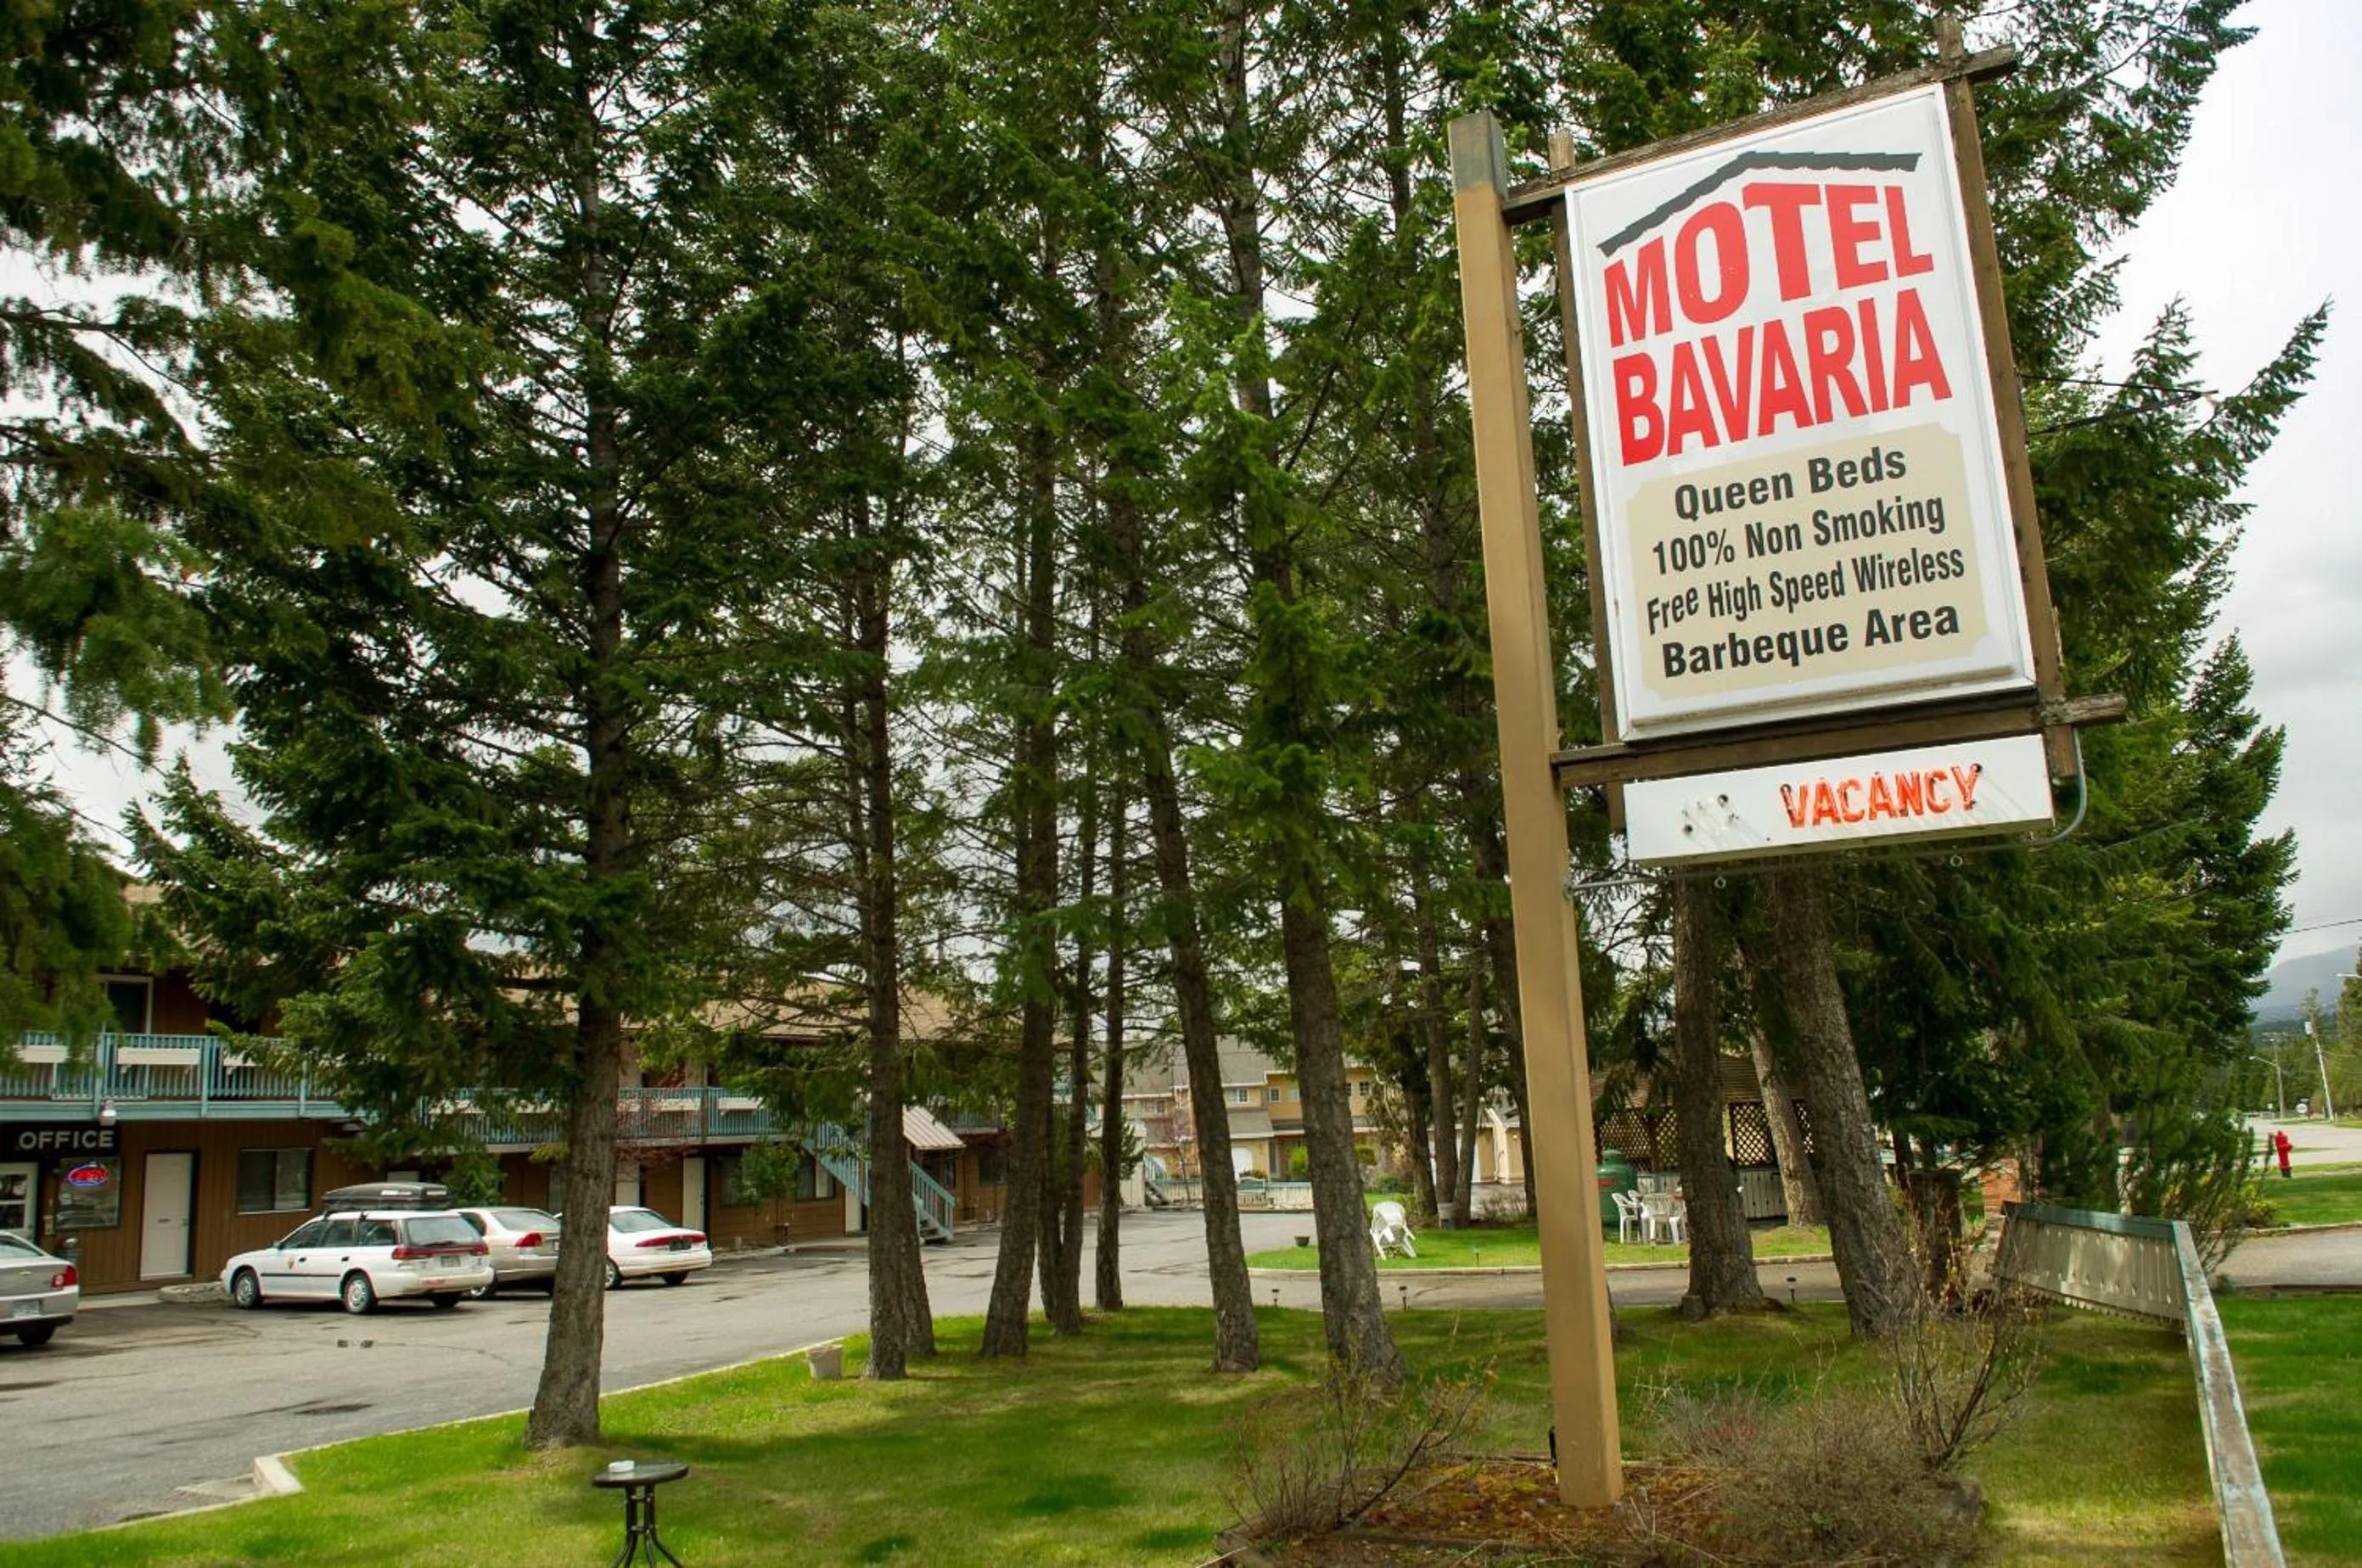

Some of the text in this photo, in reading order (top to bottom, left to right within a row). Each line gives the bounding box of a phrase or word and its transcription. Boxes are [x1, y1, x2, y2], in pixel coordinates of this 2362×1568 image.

[1603, 182, 1934, 349] MOTEL
[1612, 288, 1952, 468] BAVARIA
[1675, 446, 1906, 522] Queen Beds
[1652, 495, 1945, 575] 100% Non Smoking
[1647, 547, 1965, 636] Free High Speed Wireless
[1662, 605, 1960, 678] Barbeque Area
[1781, 764, 1982, 829] VACANCY
[19, 1130, 115, 1149] OFFICE
